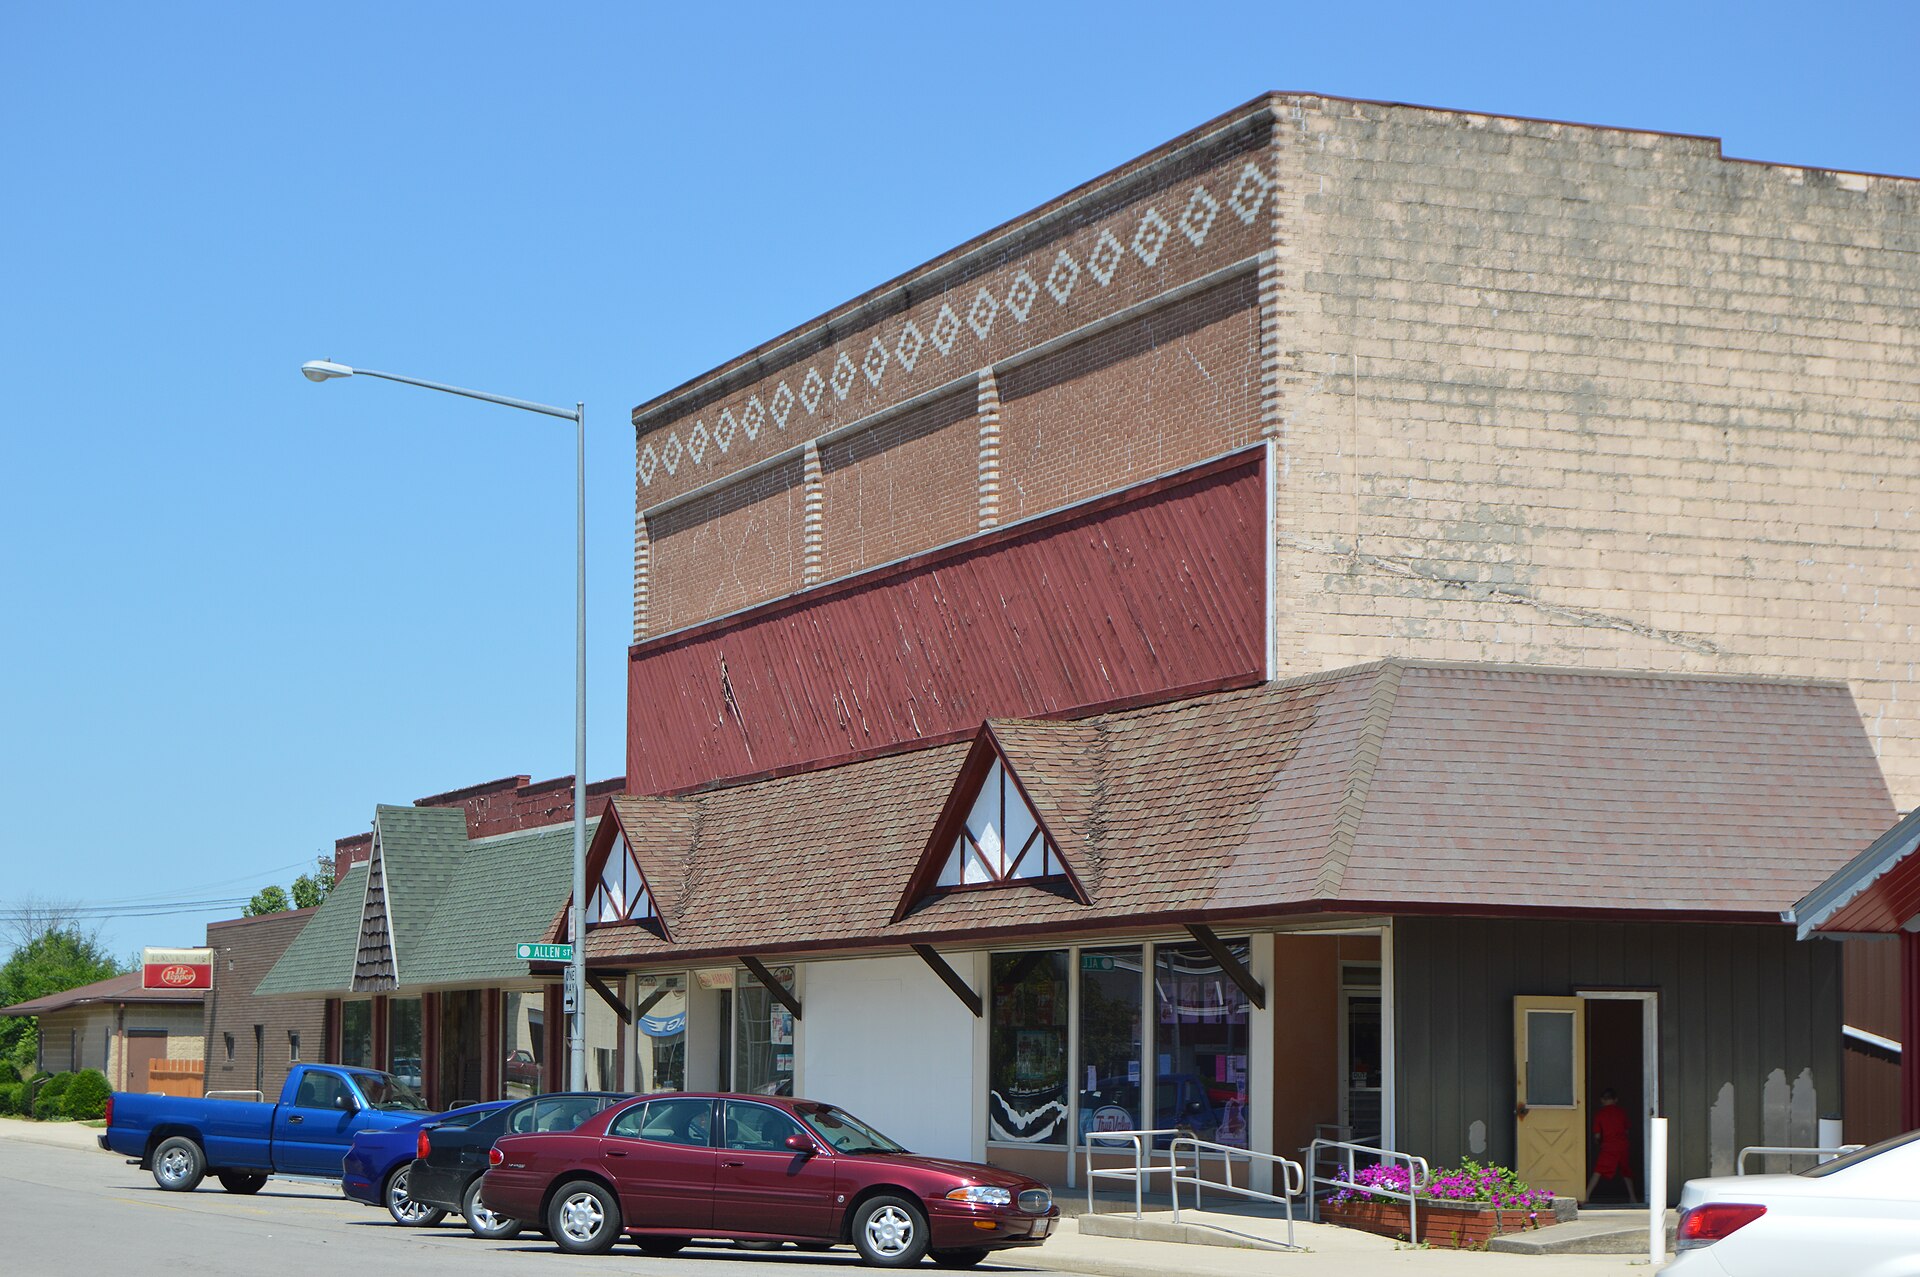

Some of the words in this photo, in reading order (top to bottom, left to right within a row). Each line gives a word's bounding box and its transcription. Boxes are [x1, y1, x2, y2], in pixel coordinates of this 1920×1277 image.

[534, 946, 560, 958] ALLEN
[562, 949, 571, 957] ST
[165, 970, 194, 983] Pepper
[175, 966, 188, 975] Dr
[565, 968, 576, 981] ONE
